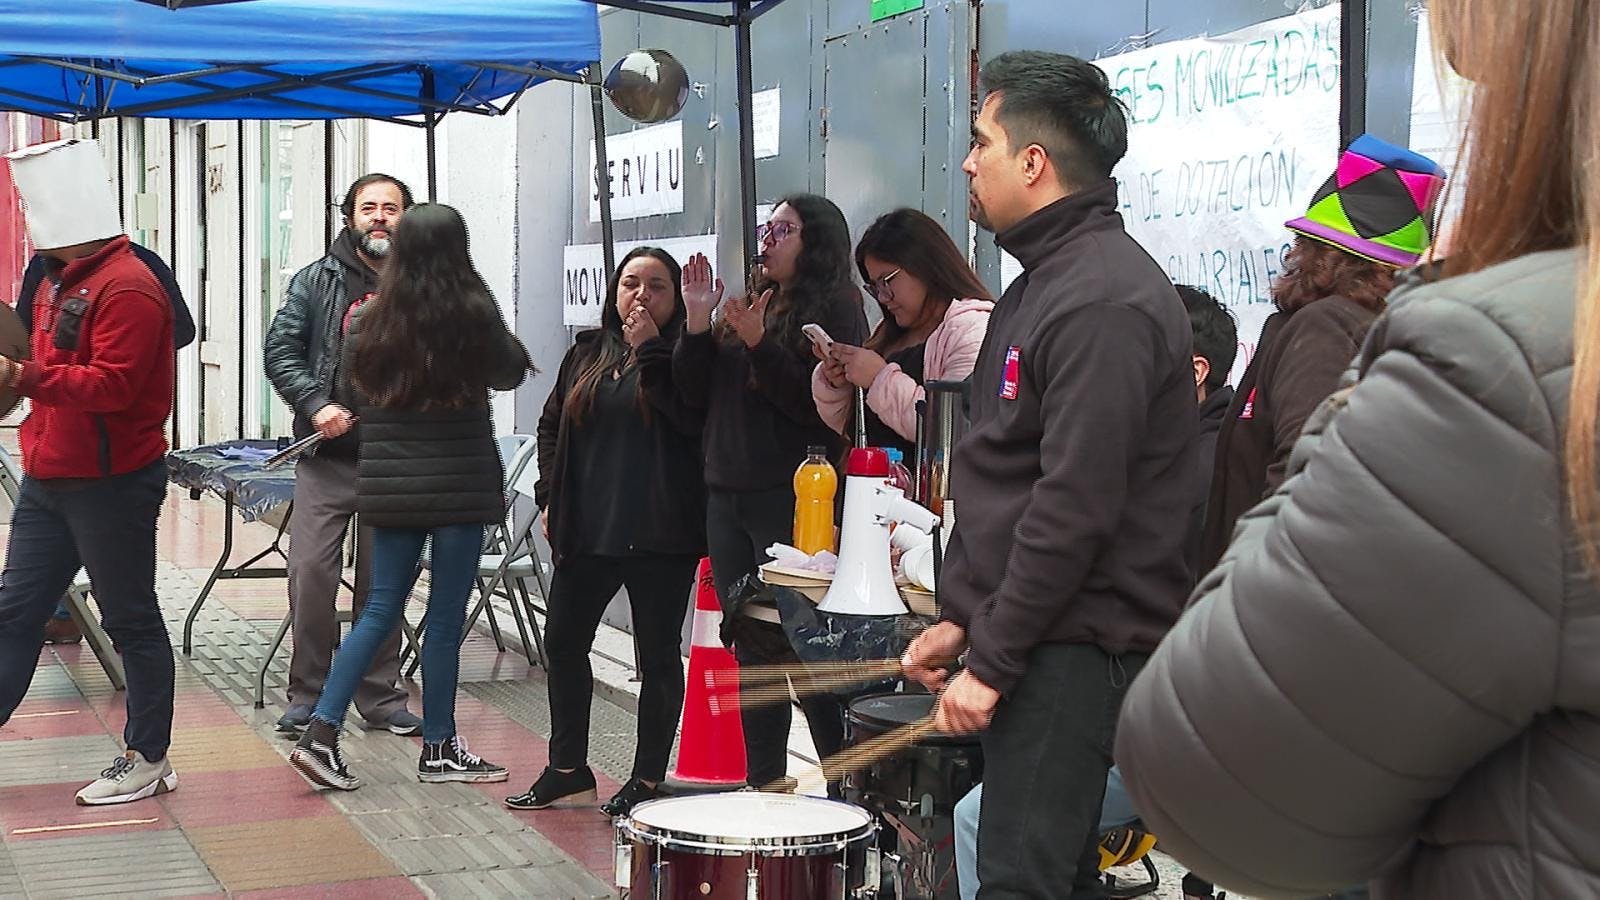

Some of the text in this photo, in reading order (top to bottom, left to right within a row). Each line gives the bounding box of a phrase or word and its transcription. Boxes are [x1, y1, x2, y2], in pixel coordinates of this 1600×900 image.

[1174, 17, 1339, 117] MOVILIZADAS
[593, 147, 679, 201] SERVIU
[1140, 168, 1163, 222] DE
[1174, 131, 1297, 218] DOTACIÓN
